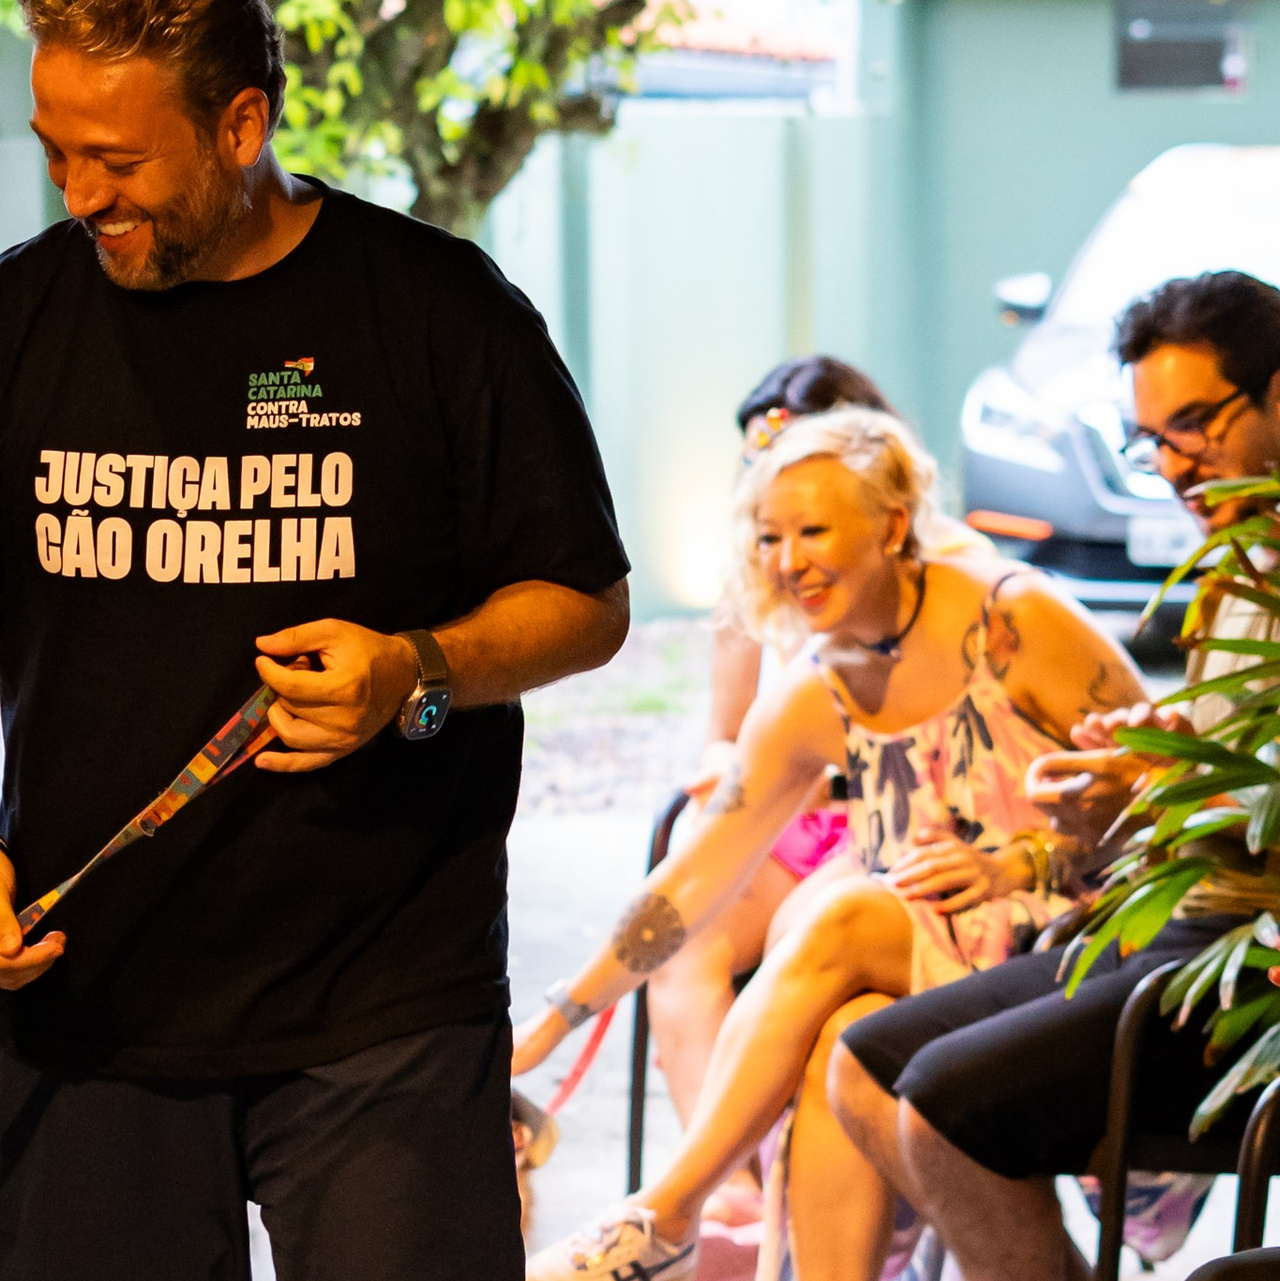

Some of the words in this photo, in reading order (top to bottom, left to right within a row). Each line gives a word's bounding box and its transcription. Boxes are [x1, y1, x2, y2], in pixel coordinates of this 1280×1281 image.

[248, 371, 301, 387] SANTA
[247, 384, 323, 400] CATARINA
[246, 400, 308, 415] CONTRA
[246, 412, 362, 429] MAUS-TRATOS
[34, 449, 231, 518] JUSTIÇA
[239, 452, 354, 509] PELO
[35, 509, 133, 581] CÃO
[145, 516, 356, 584] ORELHA
